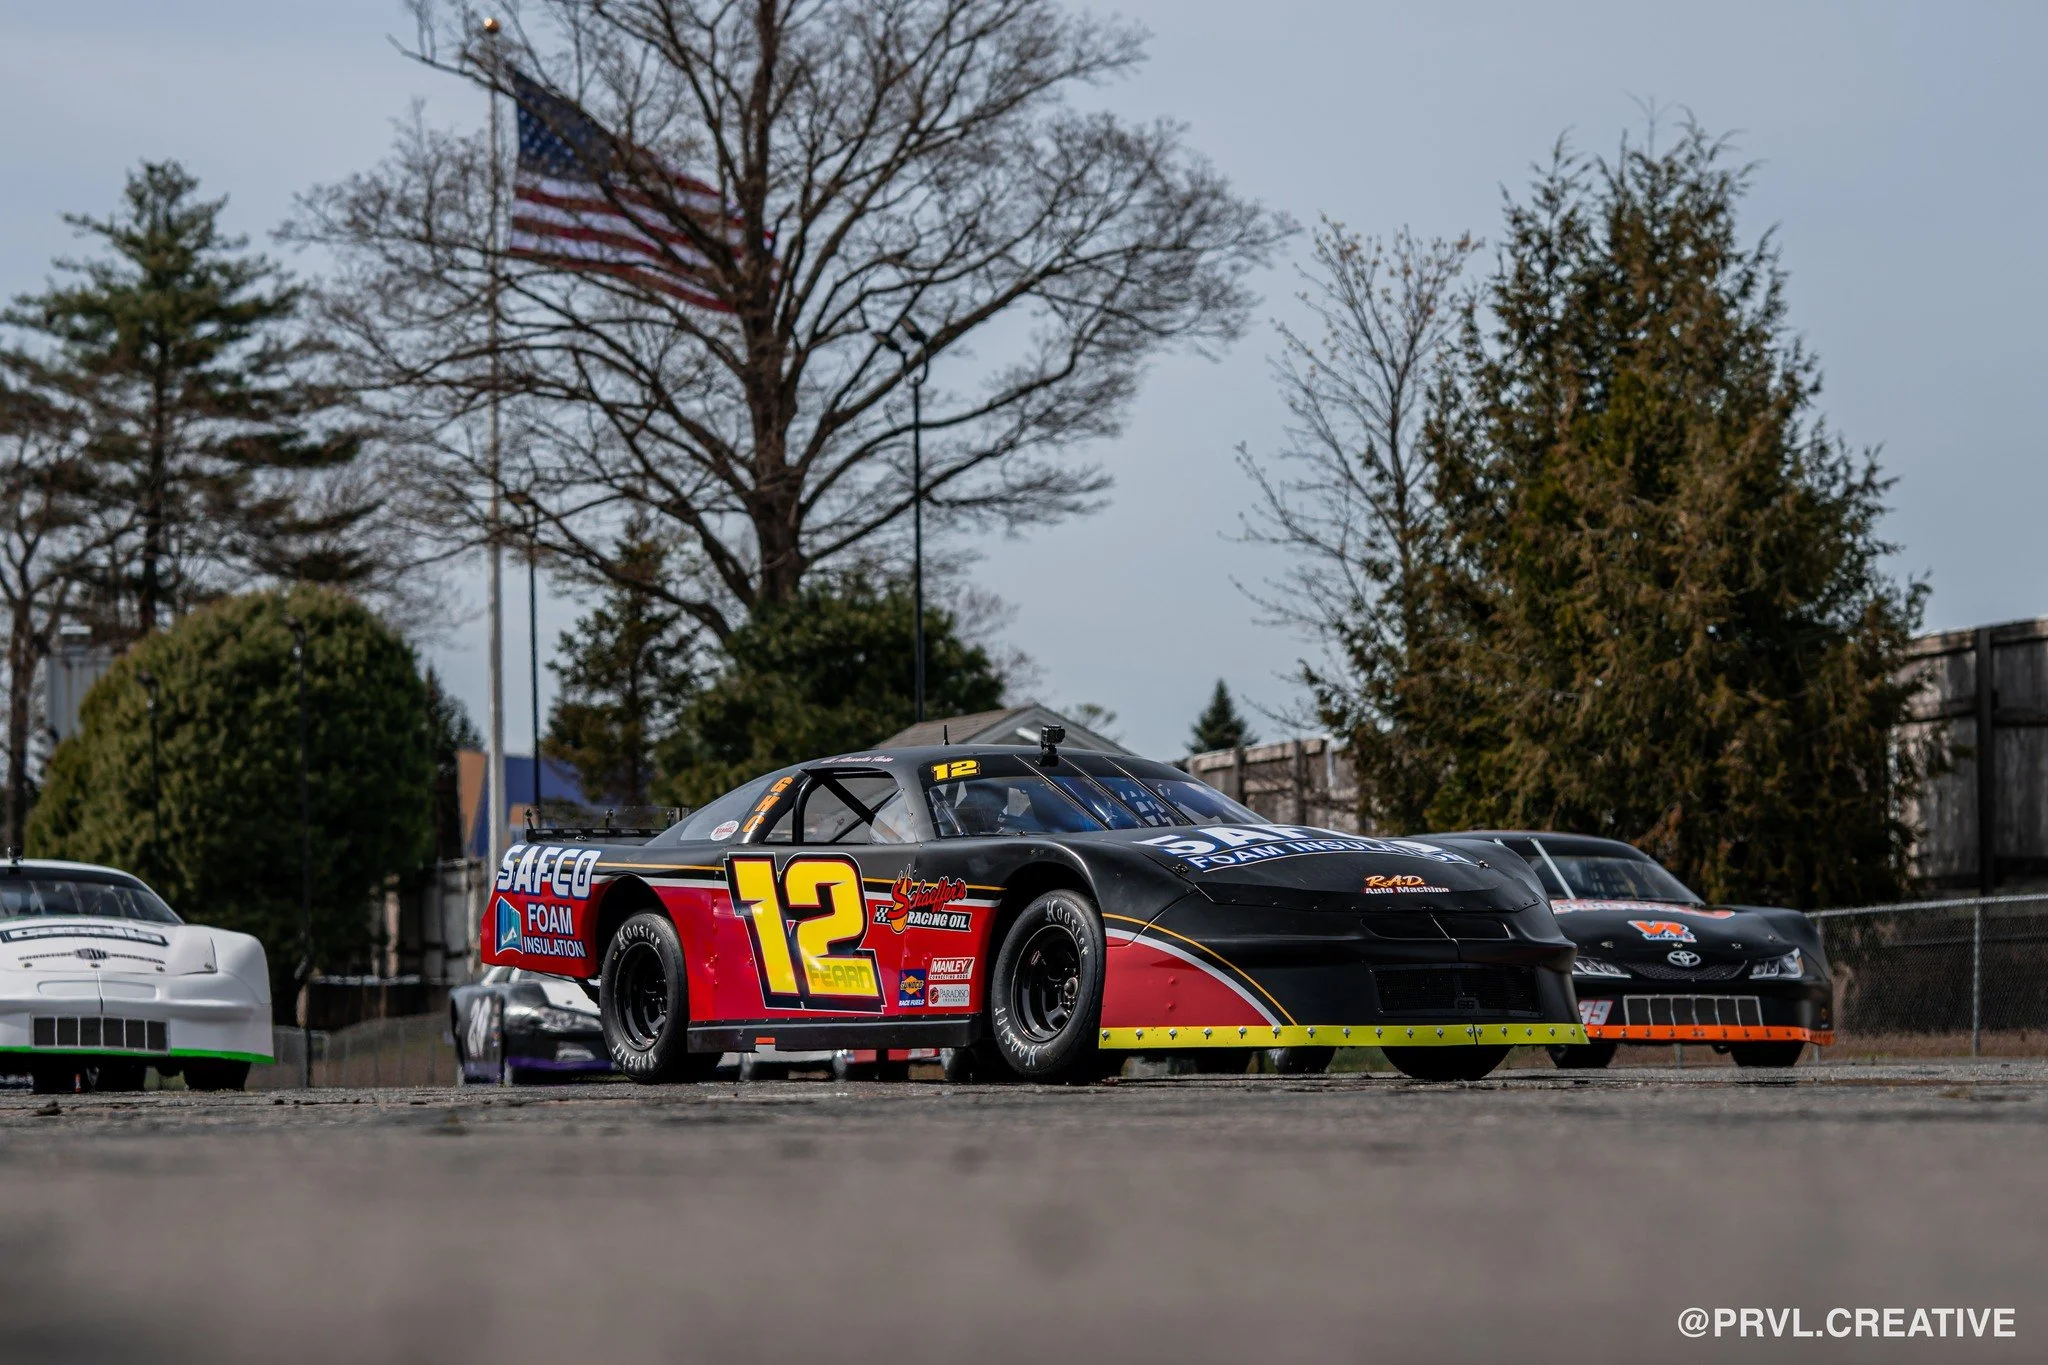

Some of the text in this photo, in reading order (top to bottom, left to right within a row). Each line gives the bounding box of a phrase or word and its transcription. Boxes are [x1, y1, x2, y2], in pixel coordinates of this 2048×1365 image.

[931, 760, 980, 781] 12
[1185, 844, 1286, 868] FOAM
[495, 844, 602, 899] SAFCO
[1365, 875, 1425, 888] R.A.D.
[887, 875, 967, 919] Schaeffer's
[1365, 885, 1450, 895] Auto Machine
[526, 902, 574, 935] FOAM
[907, 911, 968, 929] RACING OIL
[617, 922, 662, 951] Hoosier
[728, 856, 884, 1007] 12
[523, 936, 588, 958] INSULATION
[806, 963, 874, 989] FEARN
[931, 960, 967, 974] MANLEY
[898, 999, 910, 1007] RACE
[940, 988, 969, 998] PARADISO
